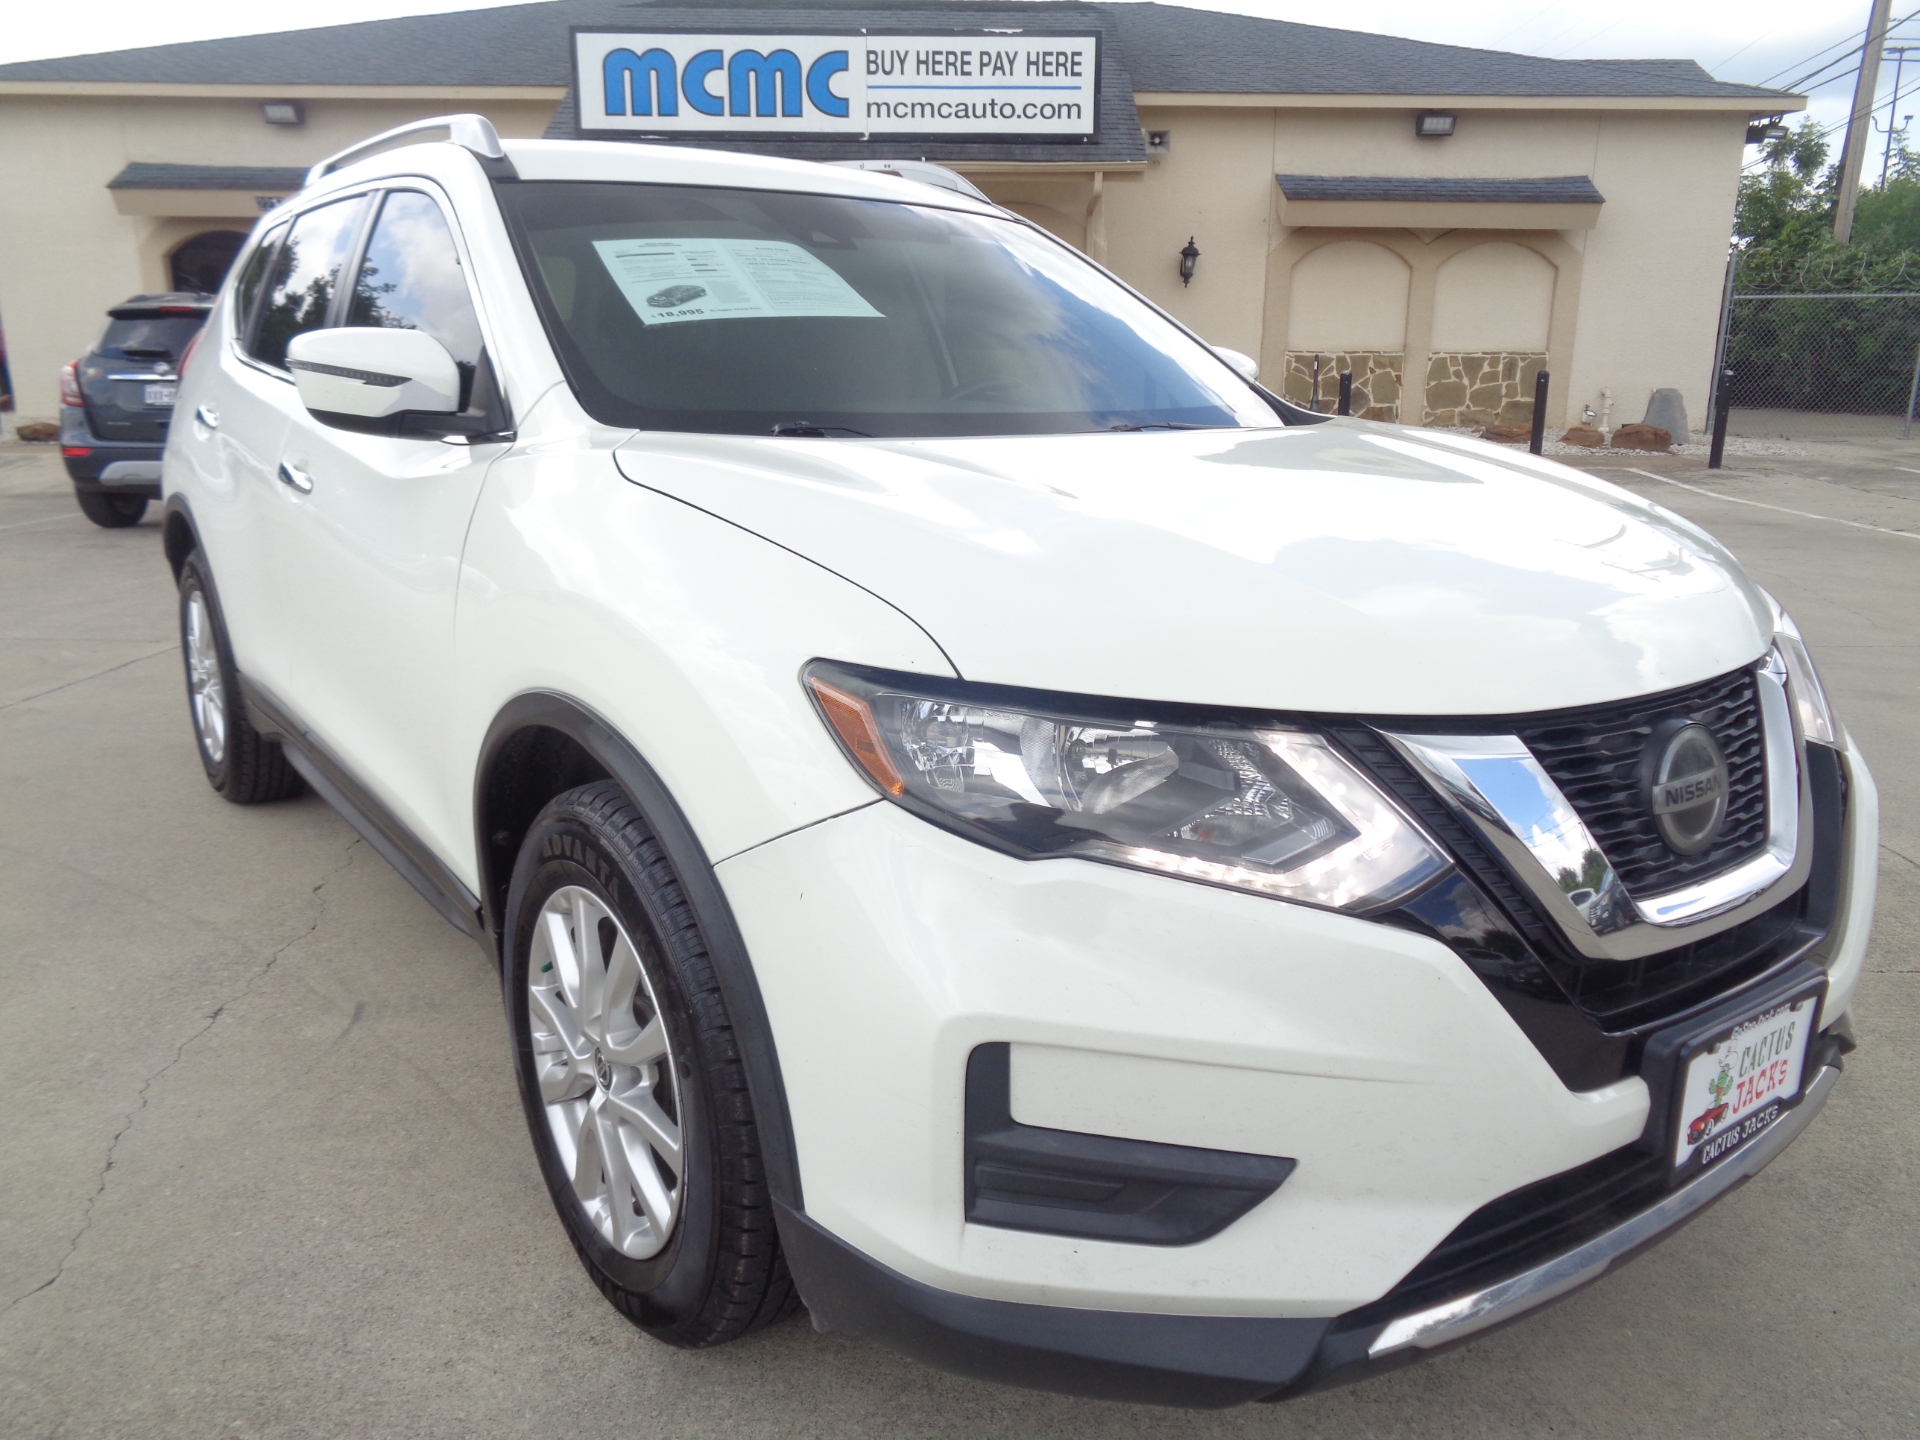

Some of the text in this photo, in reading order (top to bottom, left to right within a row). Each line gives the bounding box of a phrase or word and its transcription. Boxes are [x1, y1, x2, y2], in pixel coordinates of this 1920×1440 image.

[866, 50, 1083, 77] BUY HERE PAY HERE
[866, 98, 1082, 120] mcmcauto.com
[1666, 775, 1720, 807] NISSAN
[1739, 1021, 1796, 1078] CACTUS
[1702, 1128, 1741, 1165] CACTUS
